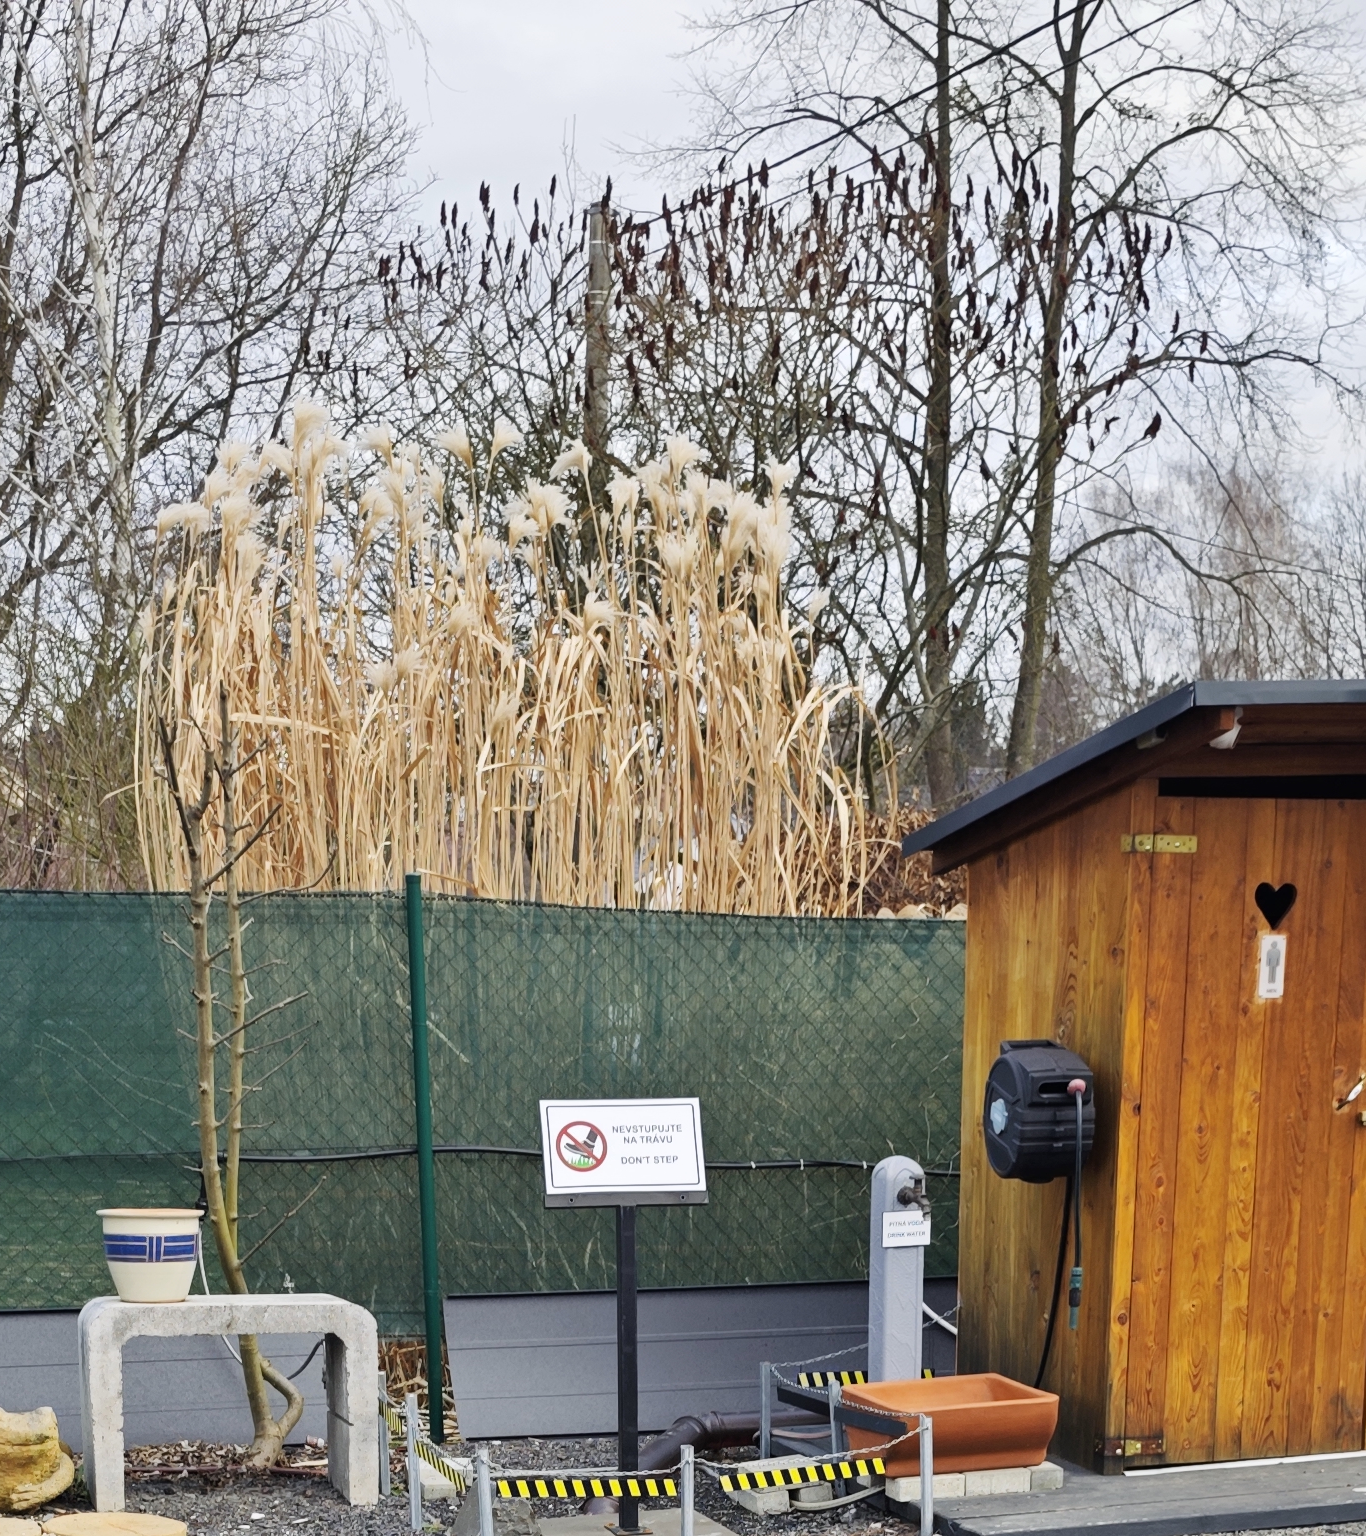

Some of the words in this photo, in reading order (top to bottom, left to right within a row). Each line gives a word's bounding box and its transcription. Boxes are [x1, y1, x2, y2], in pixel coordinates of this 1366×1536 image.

[612, 1124, 682, 1133] NEVSTUPUJTE
[623, 1136, 637, 1144] NA
[640, 1133, 673, 1144] TRÁVU
[653, 1155, 678, 1164] STEP
